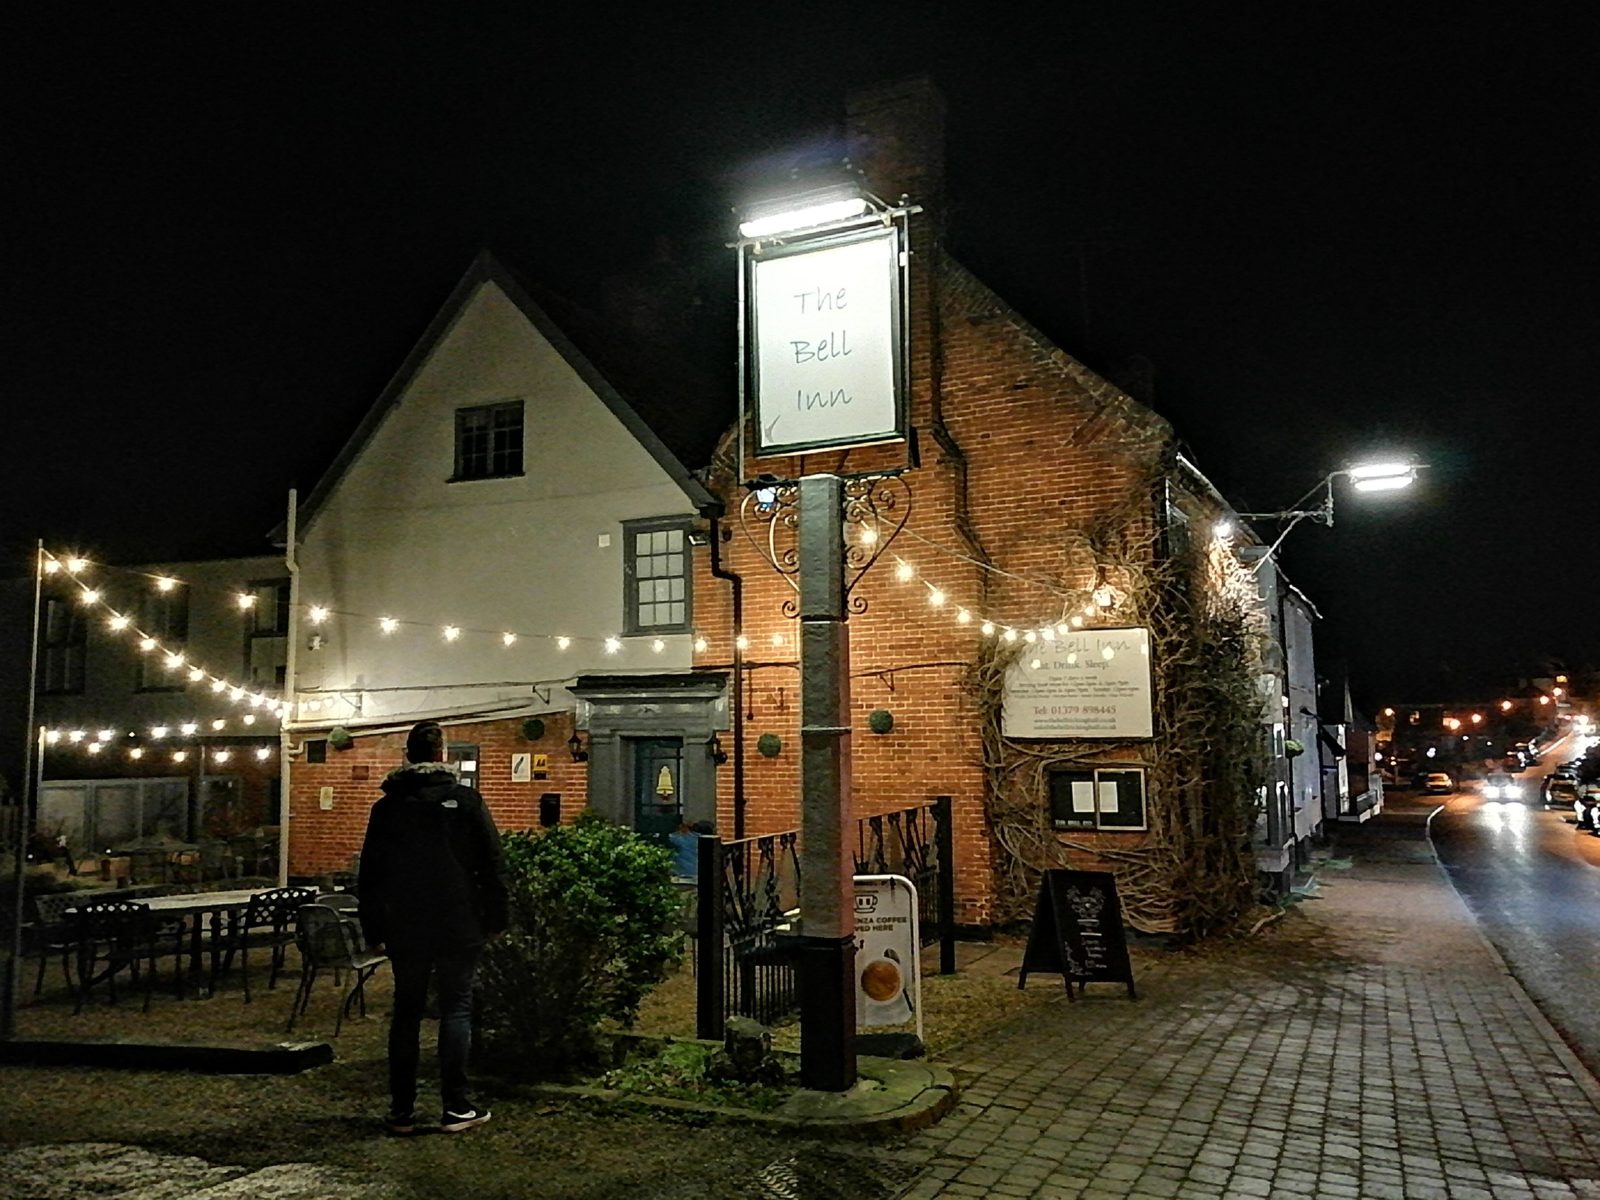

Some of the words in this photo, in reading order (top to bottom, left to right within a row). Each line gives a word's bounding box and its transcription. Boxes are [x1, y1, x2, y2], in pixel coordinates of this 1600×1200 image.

[793, 286, 847, 314] The
[790, 330, 852, 364] Bell
[797, 388, 852, 411] Inn
[1054, 637, 1089, 654] Bell
[1097, 638, 1131, 652] Inn
